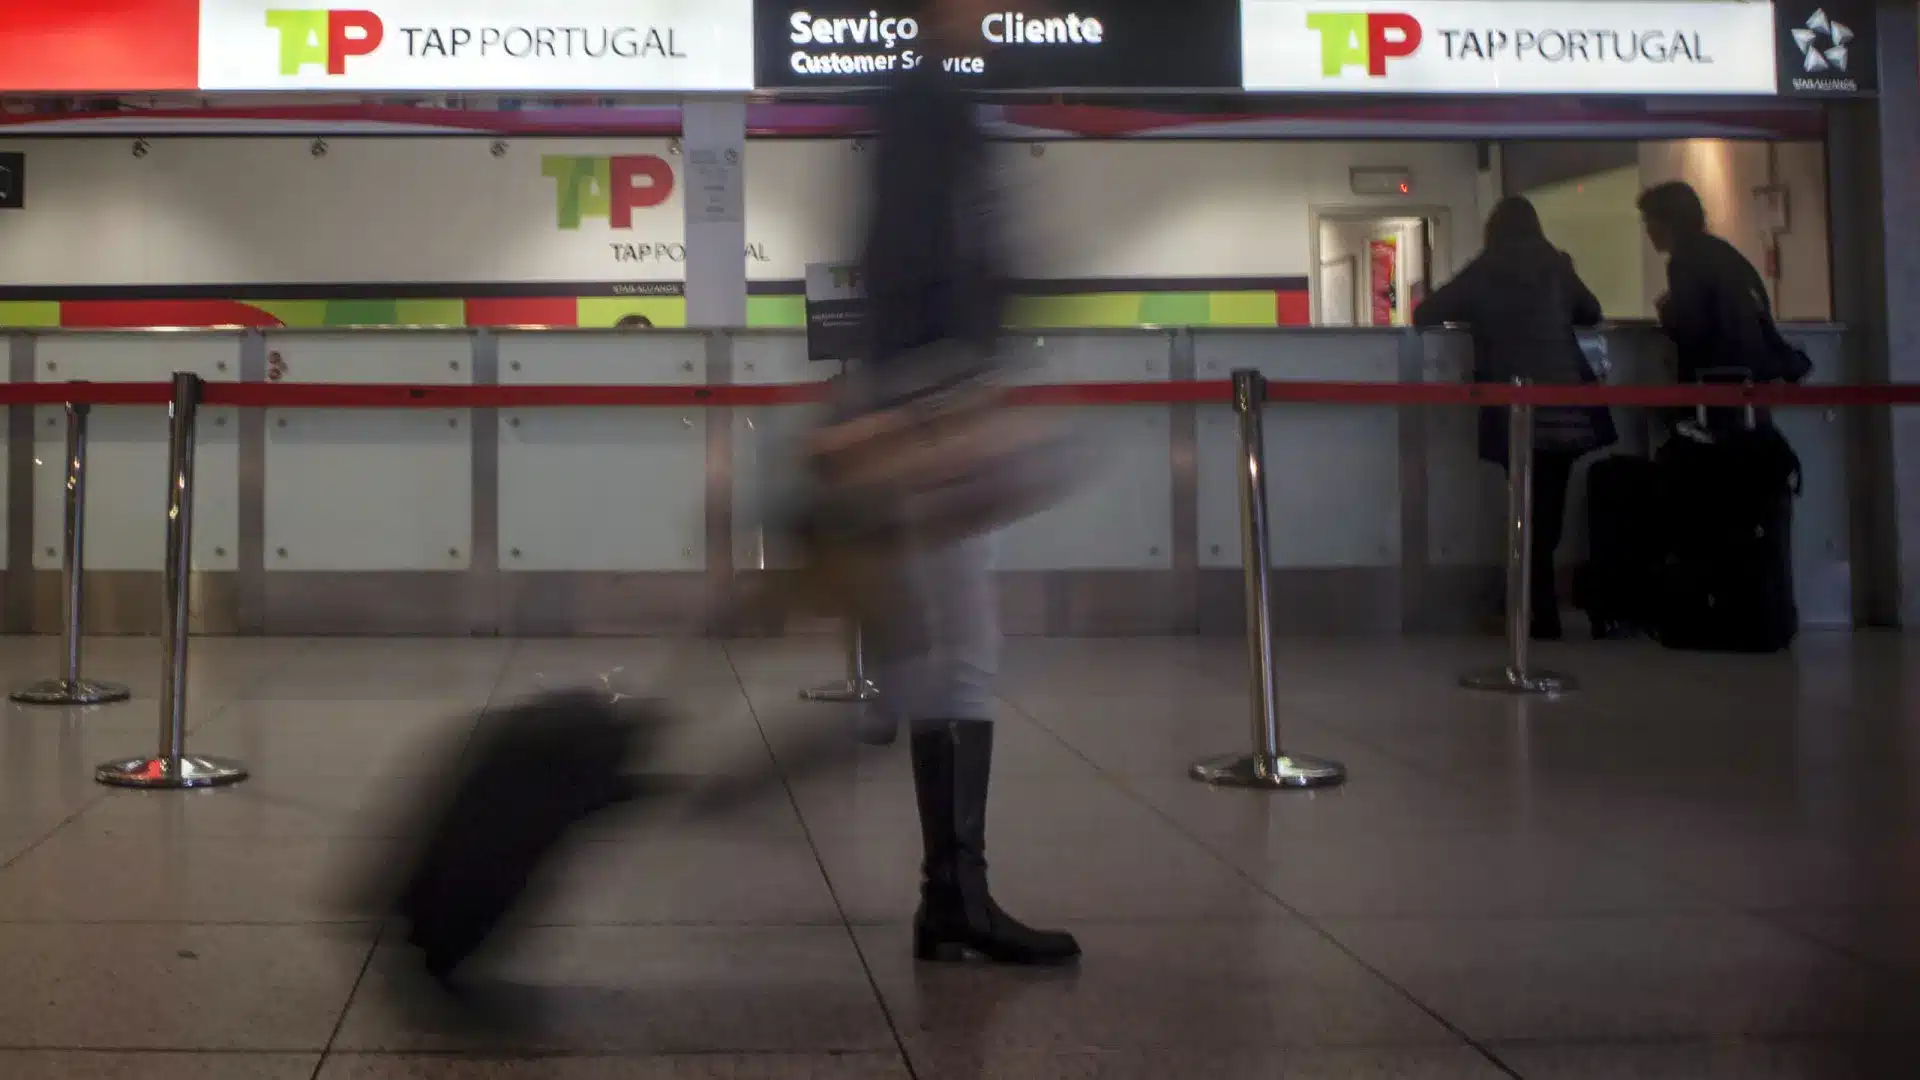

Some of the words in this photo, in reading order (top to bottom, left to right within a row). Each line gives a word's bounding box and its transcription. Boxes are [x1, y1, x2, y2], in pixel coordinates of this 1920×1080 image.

[265, 9, 384, 75] TAP
[400, 27, 471, 56] TAP
[480, 26, 687, 58] PORTUGAL
[789, 10, 919, 48] Serviço
[981, 12, 1103, 44] Cliente
[1306, 12, 1423, 77] TAP
[1437, 29, 1507, 60] TAP
[1515, 28, 1714, 64] PORTUGAL
[790, 51, 897, 74] Customer
[541, 154, 674, 230] TAP
[610, 243, 651, 262] TAP
